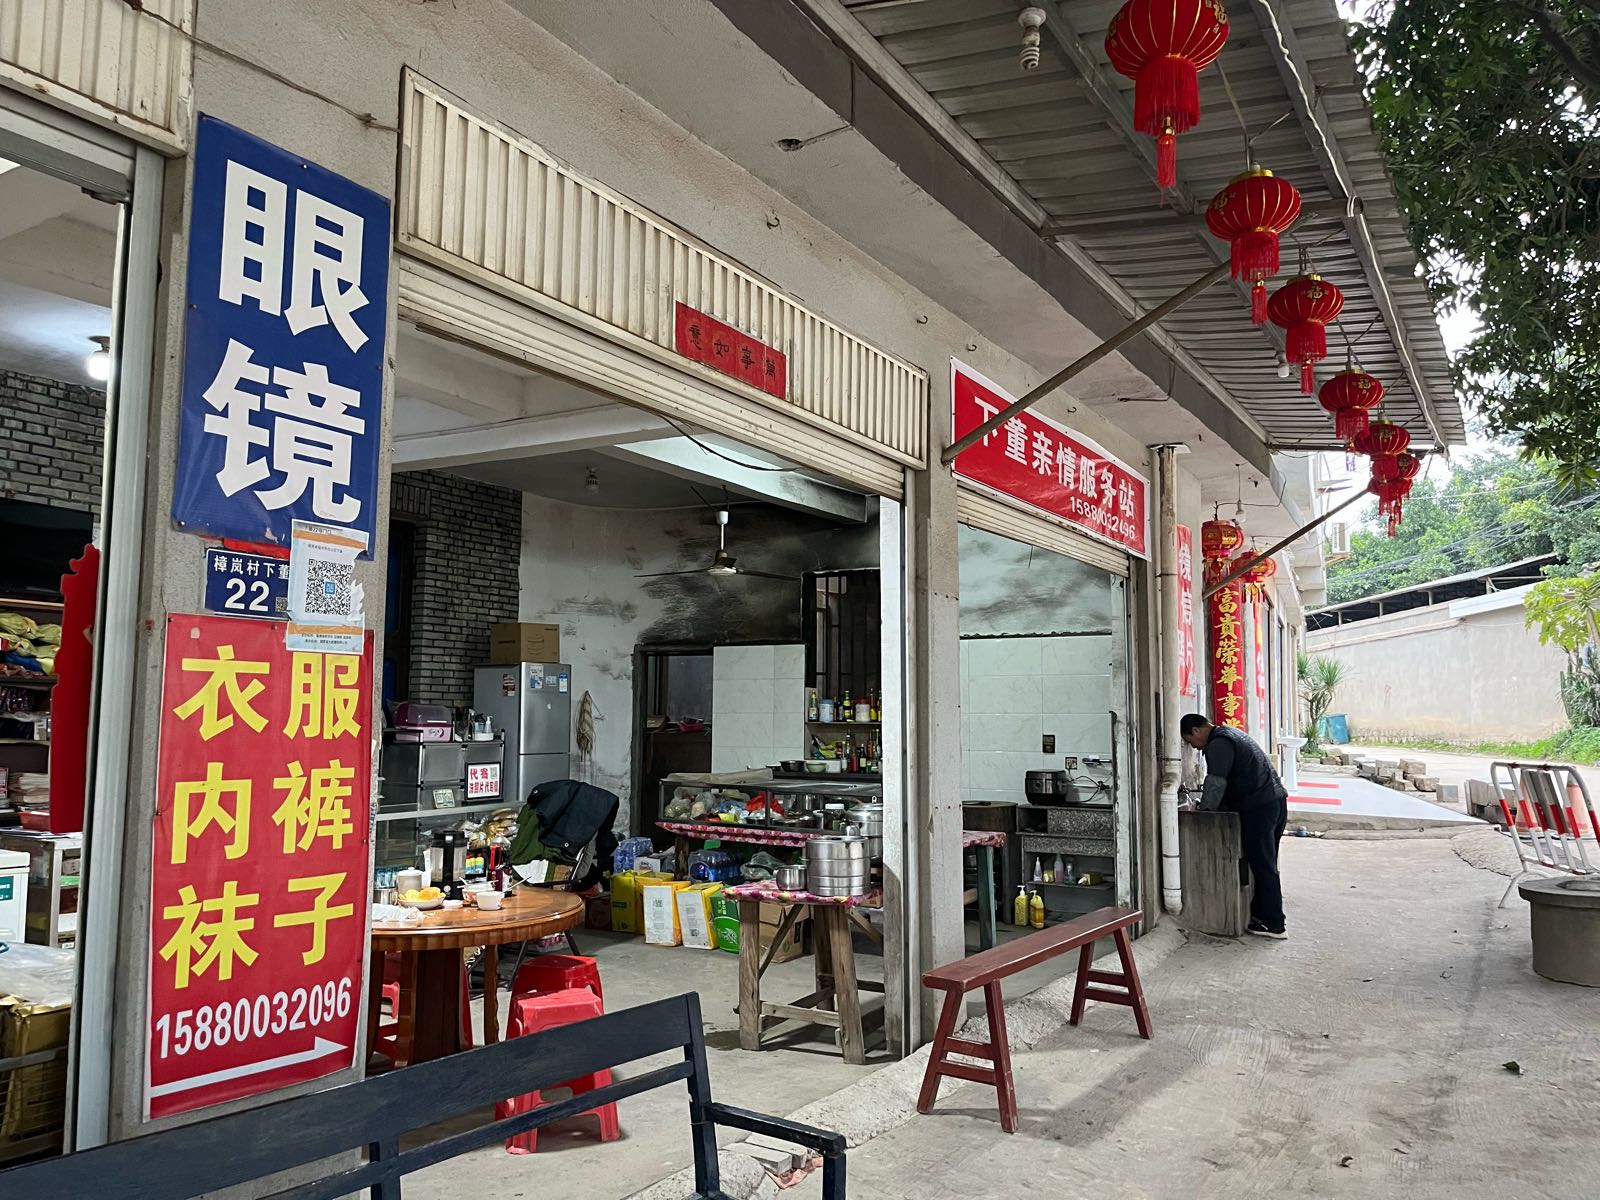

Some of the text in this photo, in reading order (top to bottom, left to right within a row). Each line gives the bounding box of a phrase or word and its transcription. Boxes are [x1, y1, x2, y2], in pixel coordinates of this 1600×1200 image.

[203, 159, 370, 522] 眼镜
[224, 578, 270, 612] 22
[173, 644, 362, 742] 衣服
[171, 759, 355, 864] 内裤
[159, 872, 354, 989] 袜子
[156, 976, 352, 1059] 15880032096
